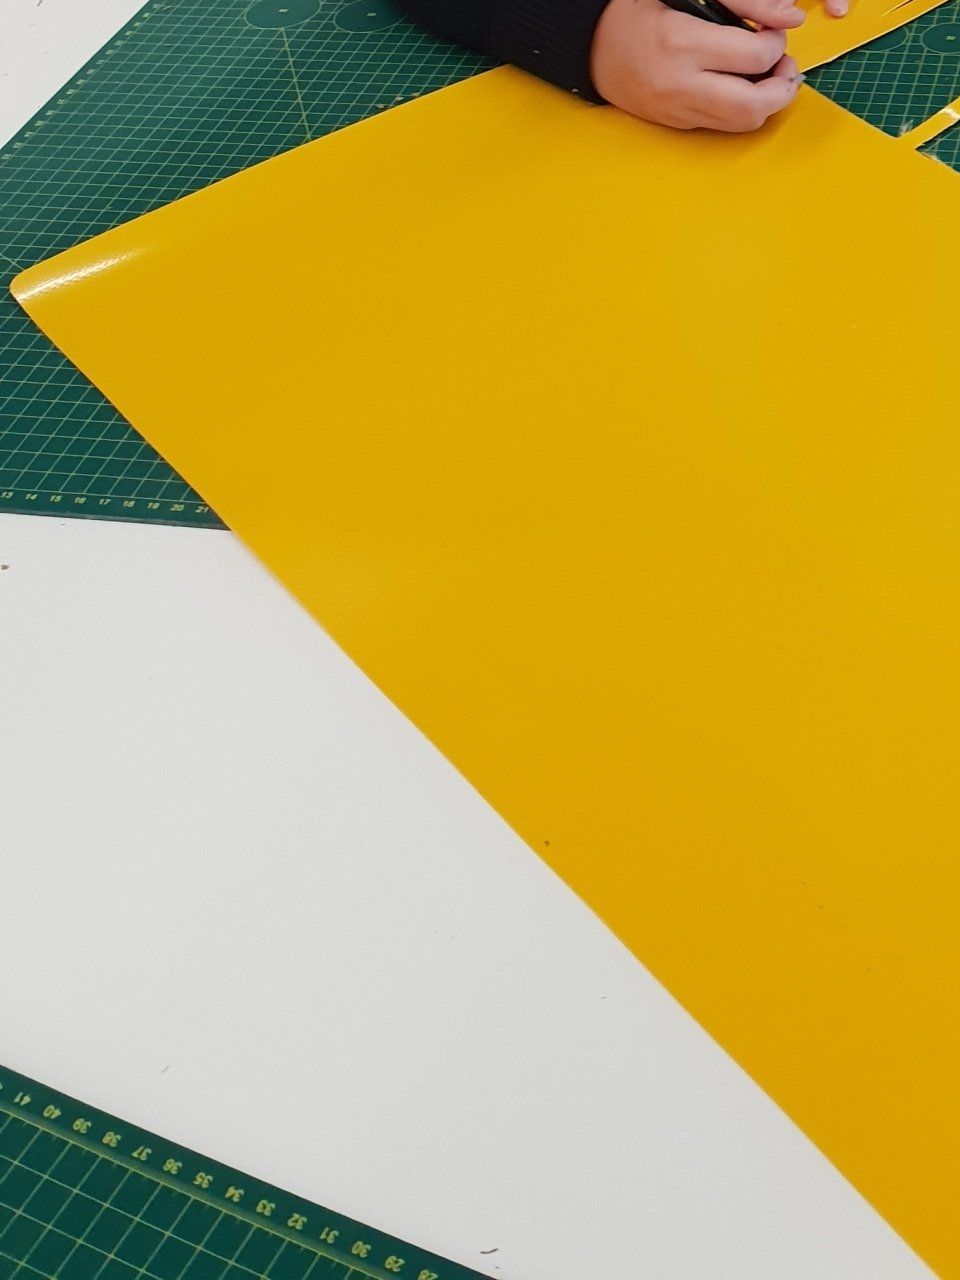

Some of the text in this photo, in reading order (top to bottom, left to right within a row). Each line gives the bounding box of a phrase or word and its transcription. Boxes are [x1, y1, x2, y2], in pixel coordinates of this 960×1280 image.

[14, 1092, 31, 1107] 41
[43, 1105, 61, 1119] 40
[132, 1146, 151, 1161] 37
[163, 1158, 182, 1175] 36
[194, 1172, 213, 1189] 35
[225, 1185, 244, 1203] 34
[287, 1213, 307, 1230] 32
[320, 1227, 339, 1243] 31
[351, 1241, 371, 1258] 30
[384, 1256, 405, 1272] 29
